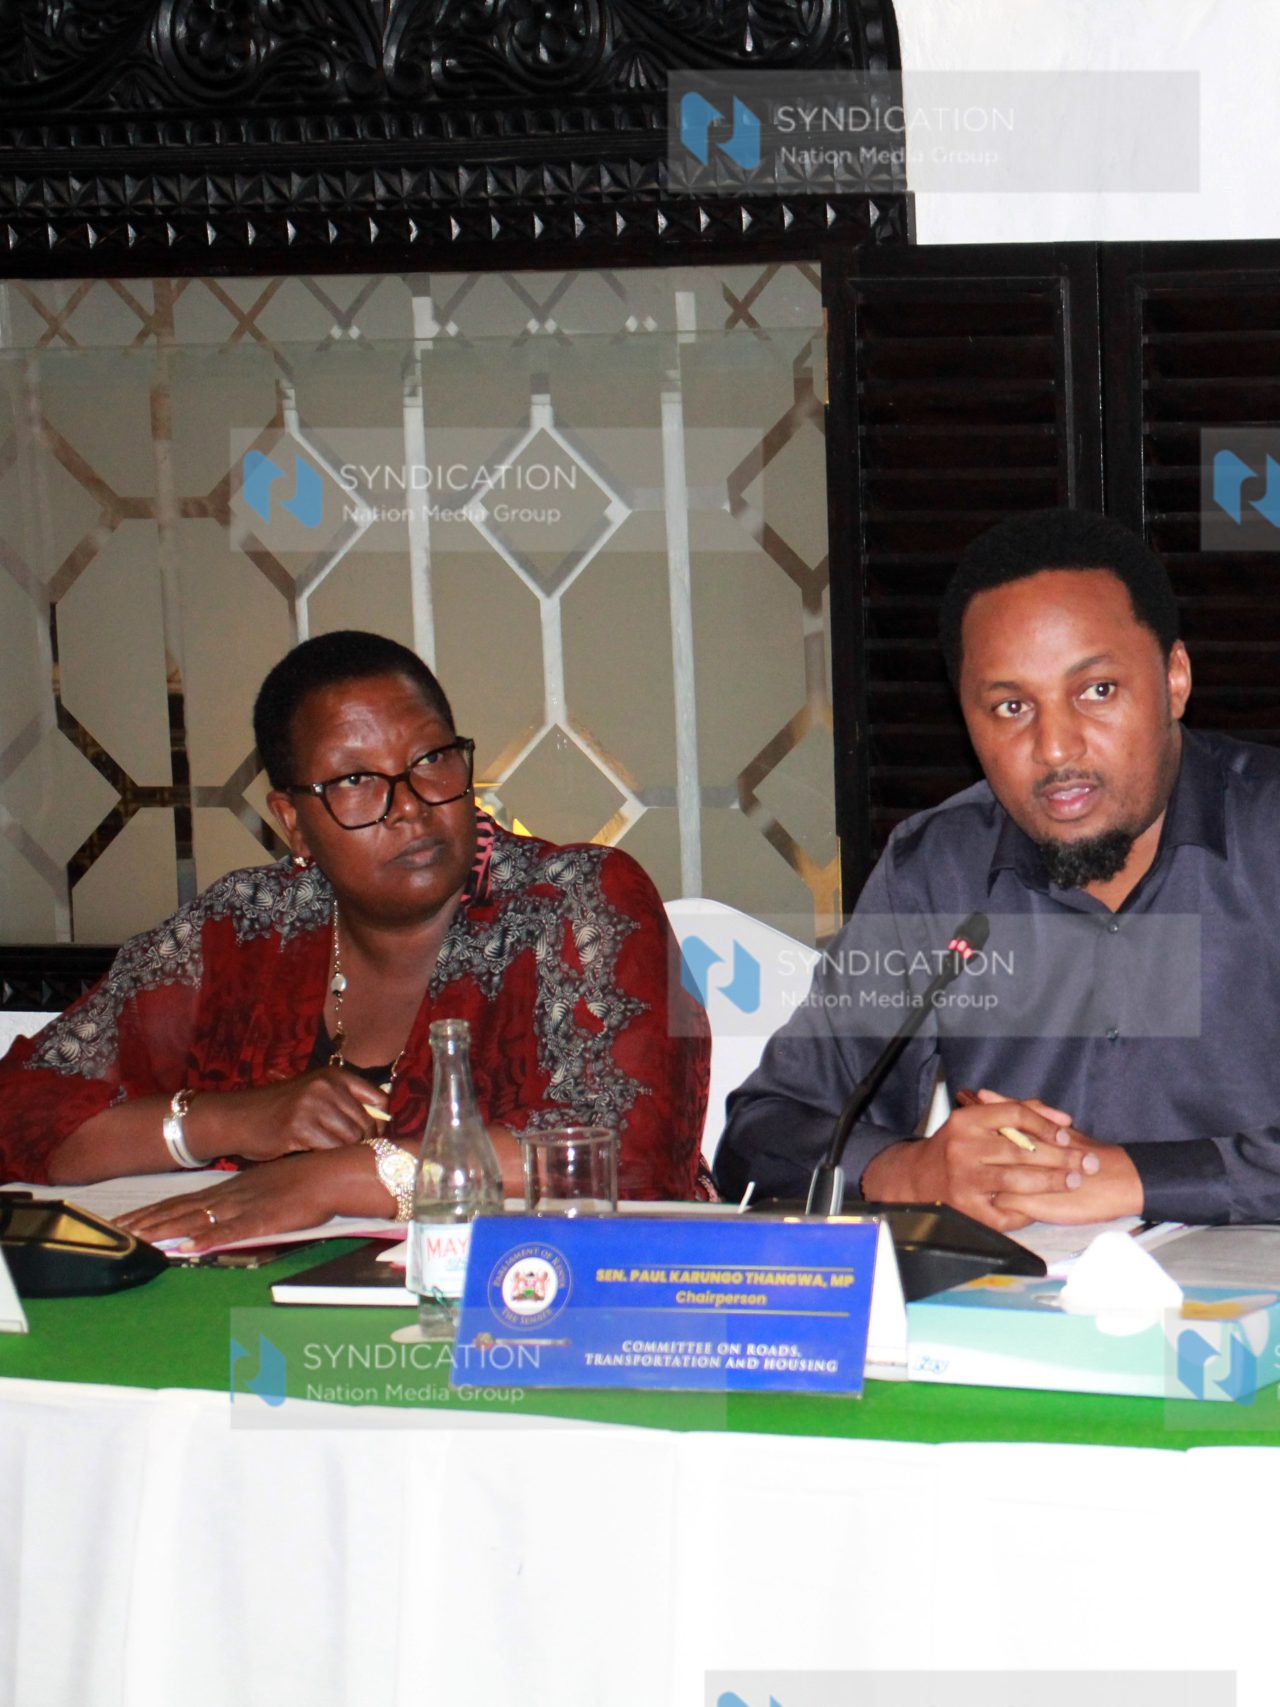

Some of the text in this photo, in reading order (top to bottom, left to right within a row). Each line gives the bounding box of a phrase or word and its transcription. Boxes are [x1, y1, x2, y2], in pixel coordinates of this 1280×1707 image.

[596, 1269, 854, 1287] SEN. PAUL KARUNGO THANGWA, MP
[675, 1290, 767, 1307] Chairperson
[622, 1340, 712, 1354] COMMITTEE
[717, 1343, 742, 1355] ON
[584, 1353, 839, 1373] TRANSPORTATION AND HOUSING
